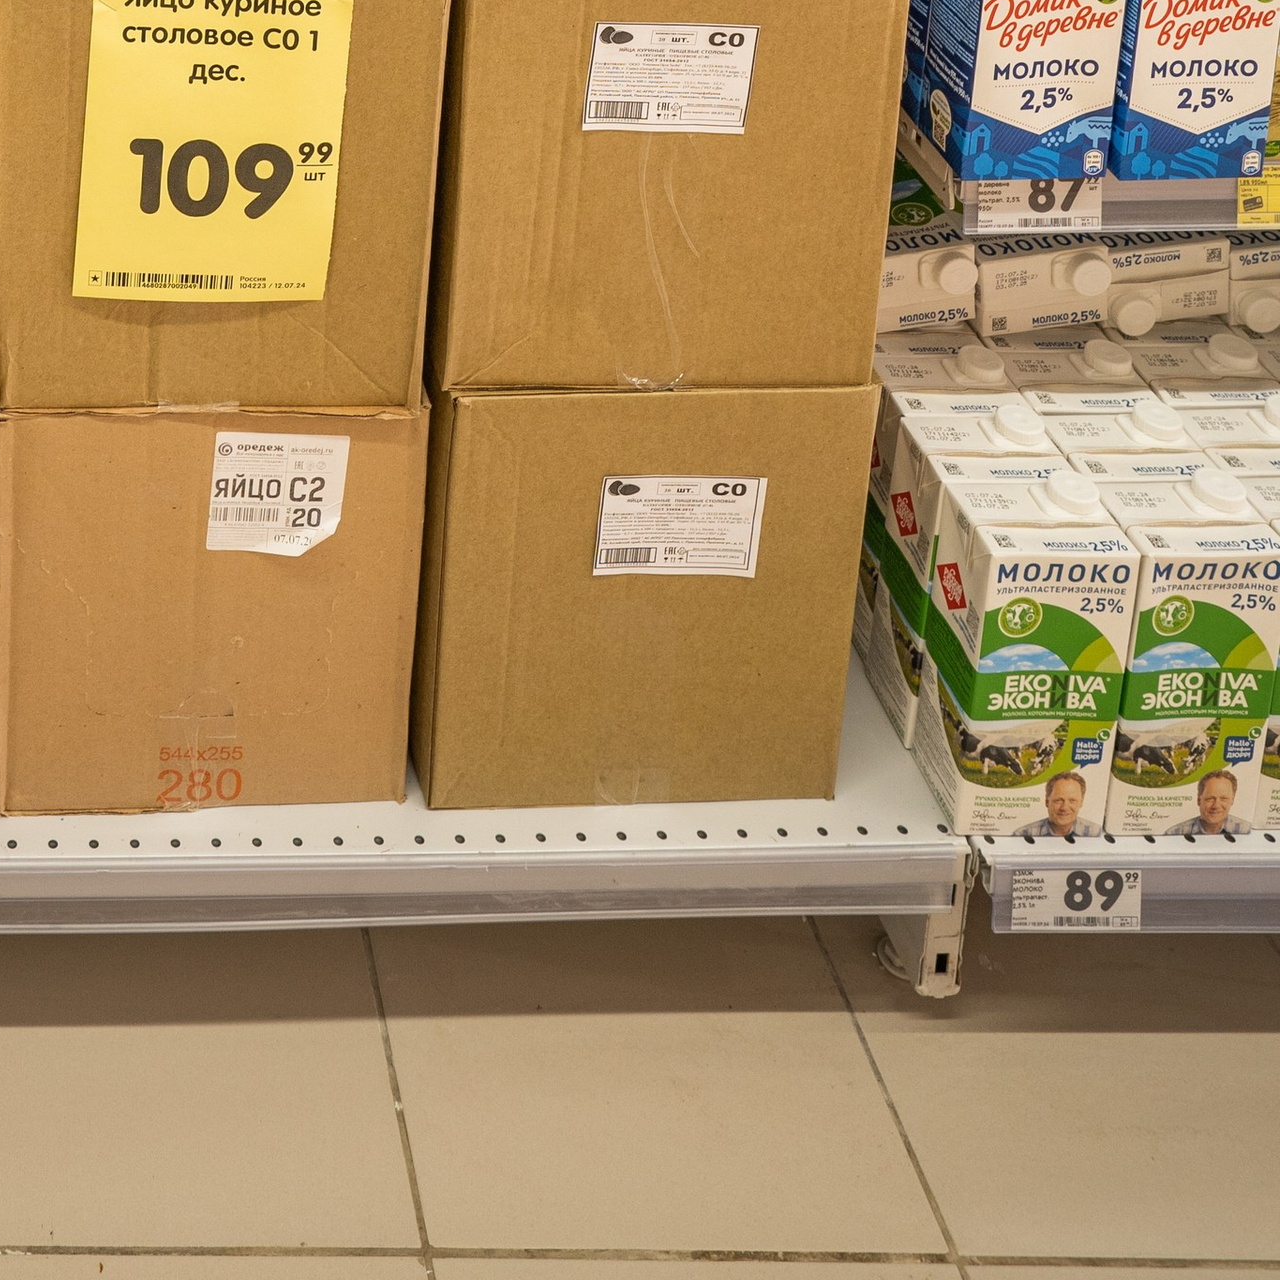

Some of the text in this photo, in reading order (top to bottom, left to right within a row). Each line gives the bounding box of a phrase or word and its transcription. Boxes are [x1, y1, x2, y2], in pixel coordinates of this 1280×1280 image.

[121, 22, 255, 49] столовое
[309, 29, 320, 52] 1
[1015, 5, 1119, 52] деревне
[188, 60, 247, 85] дес.
[993, 58, 1100, 81] МОЛОКО
[1151, 59, 1258, 78] МОЛОКО
[1020, 87, 1074, 114] 2,5%
[298, 141, 333, 165] 99
[129, 137, 295, 221] 109
[303, 170, 326, 183] шт
[214, 473, 281, 501] ЯЙЦО
[997, 563, 1131, 584] МОЛОКО
[996, 586, 1127, 596] УЛЬТРАПАСТЕРИЗОВАННОЕ
[1080, 597, 1124, 614] 2,5%
[1004, 675, 1107, 694] EKONIVA
[987, 691, 1096, 711] ЭКОНИВА
[1141, 691, 1248, 709] ЭКОНИВА
[1125, 872, 1139, 882] 99
[1064, 871, 1123, 911] 89
